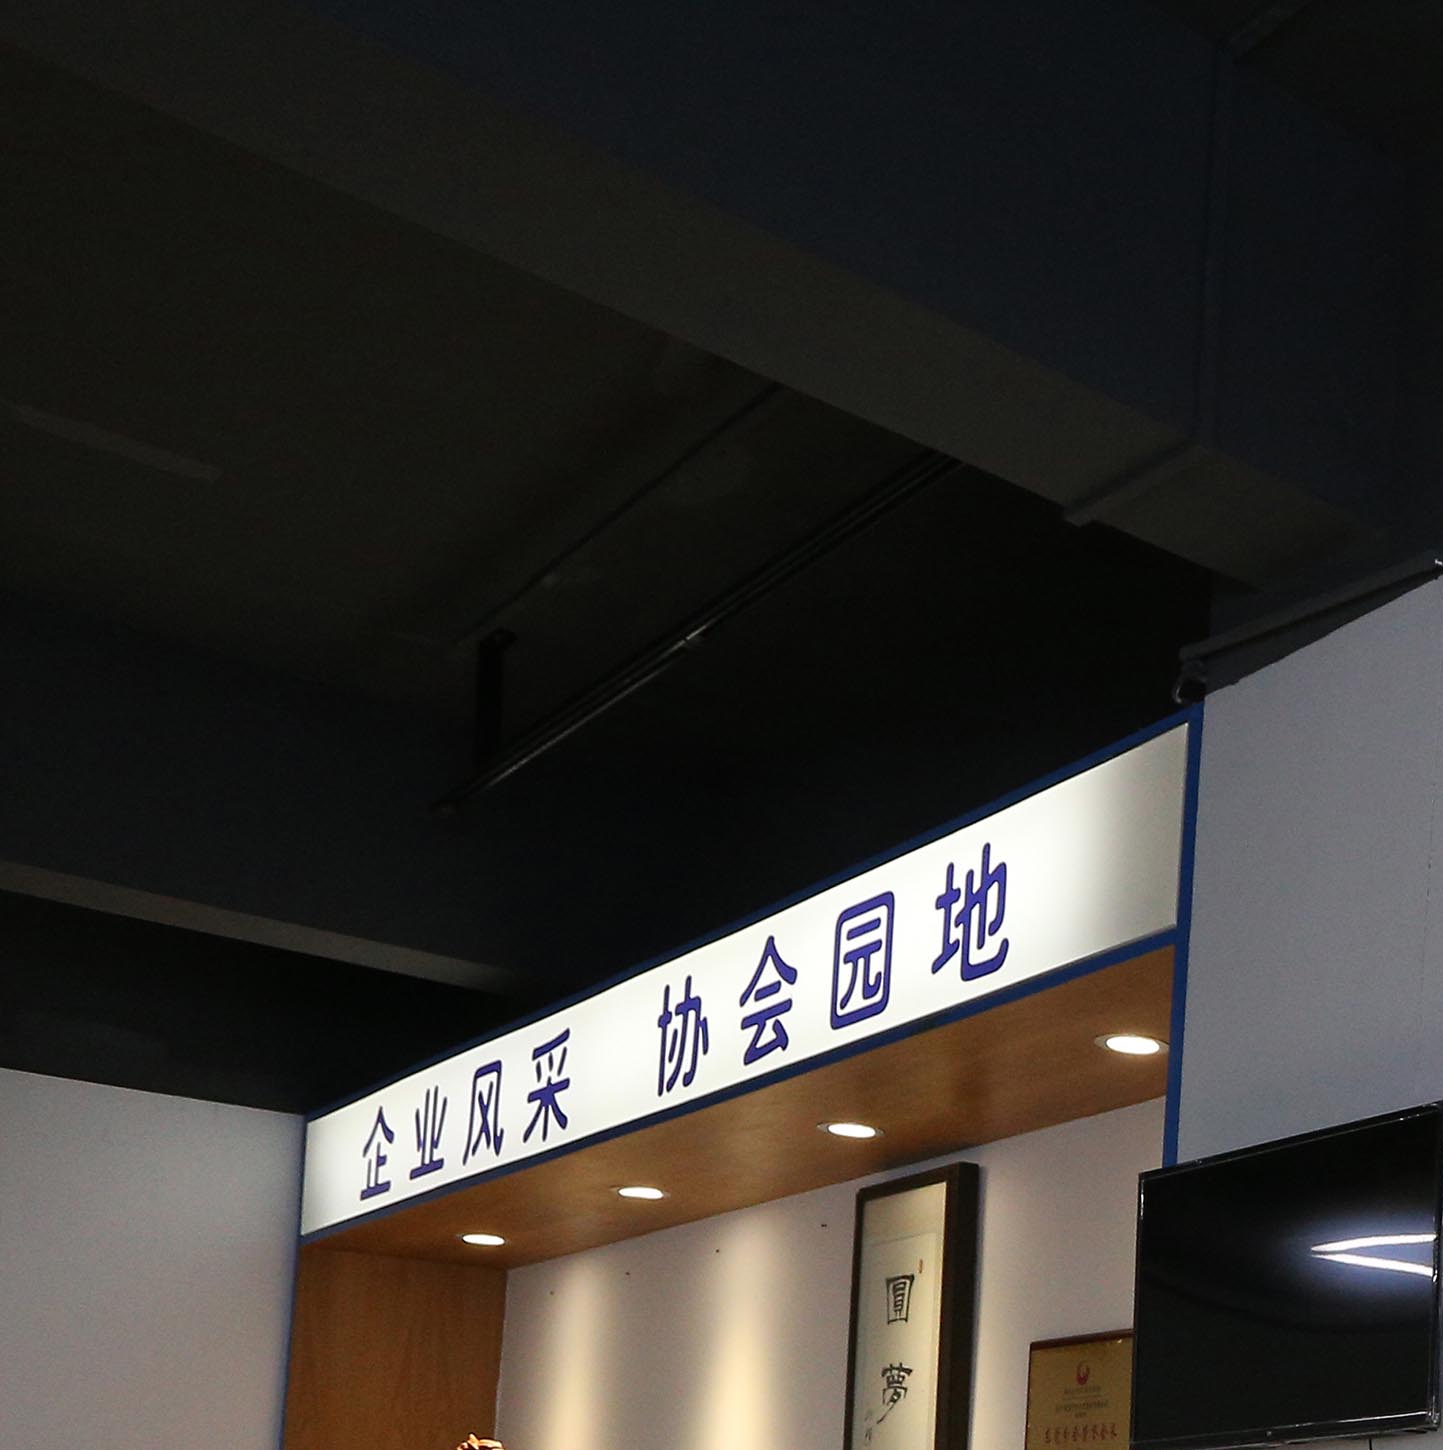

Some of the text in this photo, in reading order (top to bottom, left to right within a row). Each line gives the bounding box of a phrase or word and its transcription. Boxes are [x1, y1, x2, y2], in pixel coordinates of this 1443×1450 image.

[359, 842, 1010, 1200] 企业风采 协会园地
